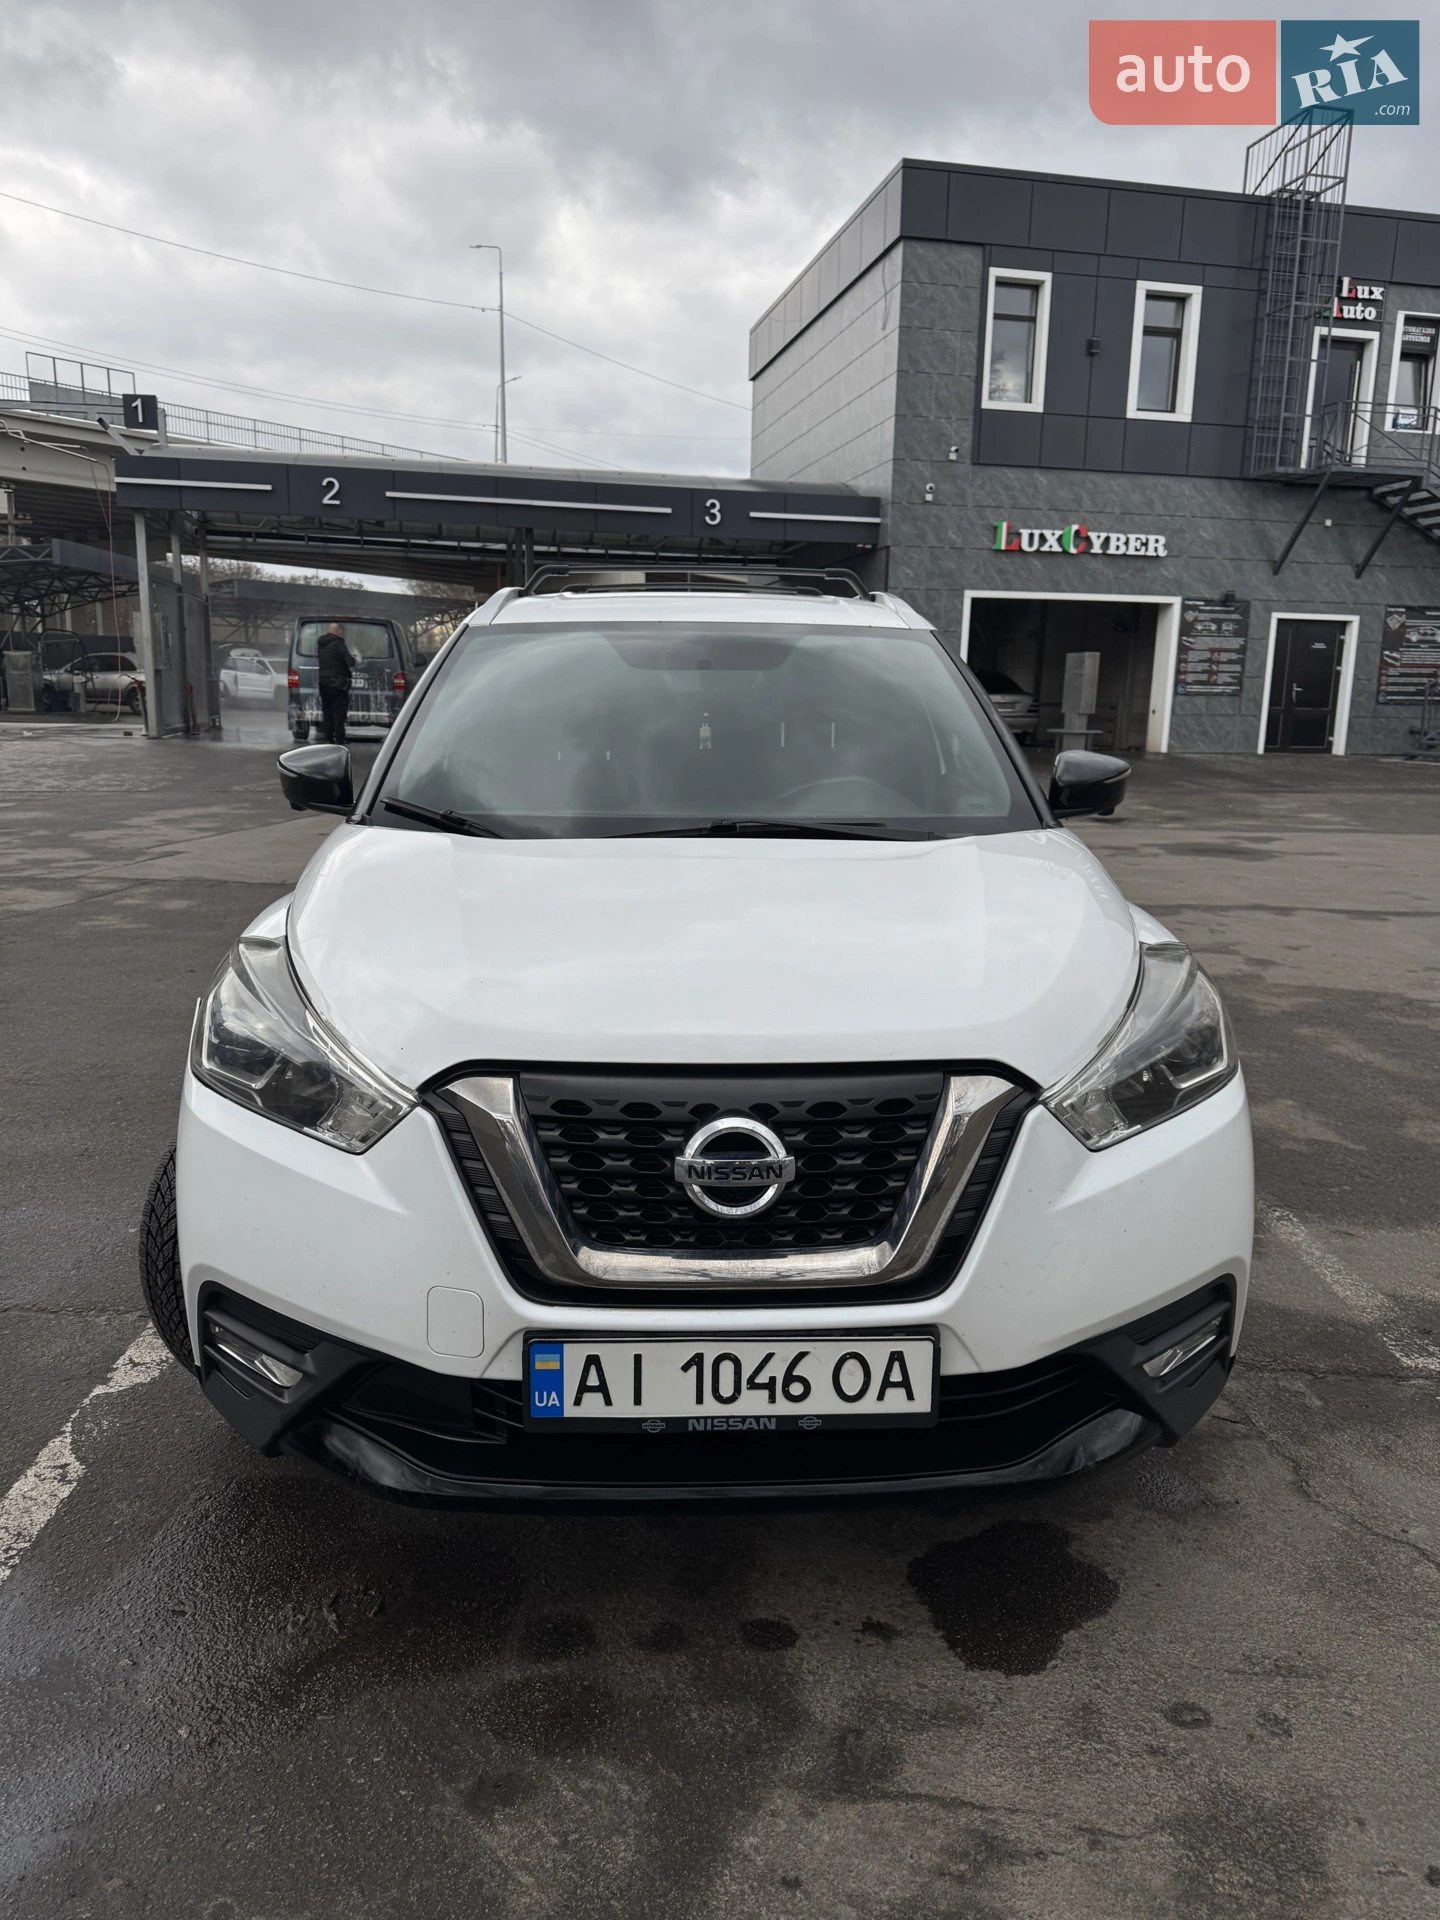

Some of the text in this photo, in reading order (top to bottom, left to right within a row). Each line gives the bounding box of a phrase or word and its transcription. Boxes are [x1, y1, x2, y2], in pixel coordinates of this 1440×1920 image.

[1340, 277, 1385, 300] Lux
[1322, 297, 1377, 321] Auto
[131, 397, 144, 423] 1
[321, 477, 341, 505] 2
[704, 498, 722, 525] 3
[688, 1165, 783, 1181] NISSAN
[572, 1350, 916, 1407] AI 1046 OA
[535, 1391, 560, 1408] UA
[688, 1417, 777, 1431] NISSAN
